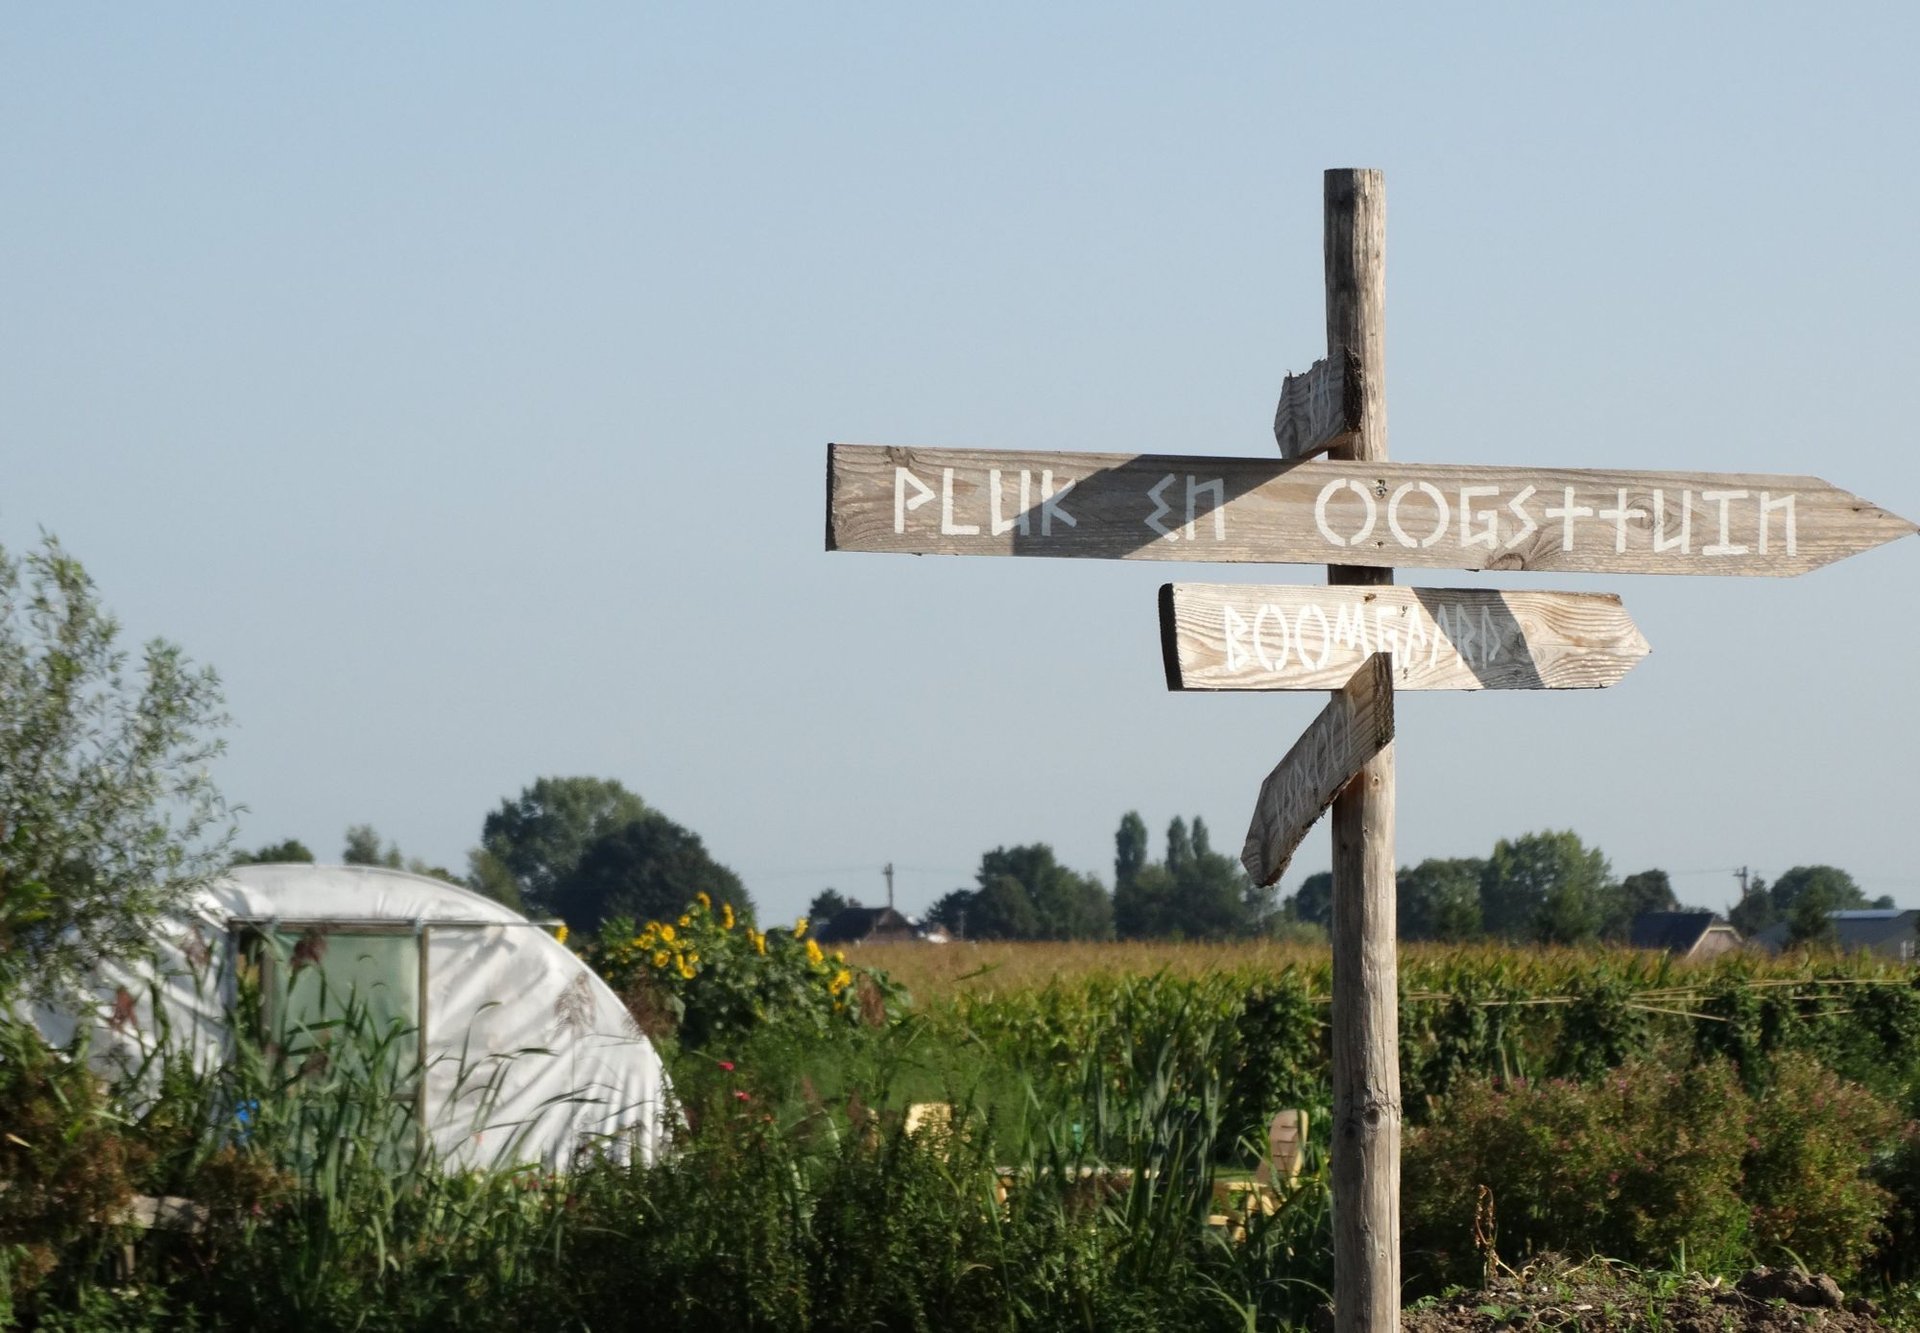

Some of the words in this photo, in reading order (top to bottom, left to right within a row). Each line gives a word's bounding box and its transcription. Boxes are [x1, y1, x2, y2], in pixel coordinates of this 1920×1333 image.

[894, 466, 1078, 537] PLUK
[1144, 472, 1226, 543] EN
[1314, 477, 1798, 557] OOGSTTUIN
[1223, 602, 1501, 673] BOOMGAARD
